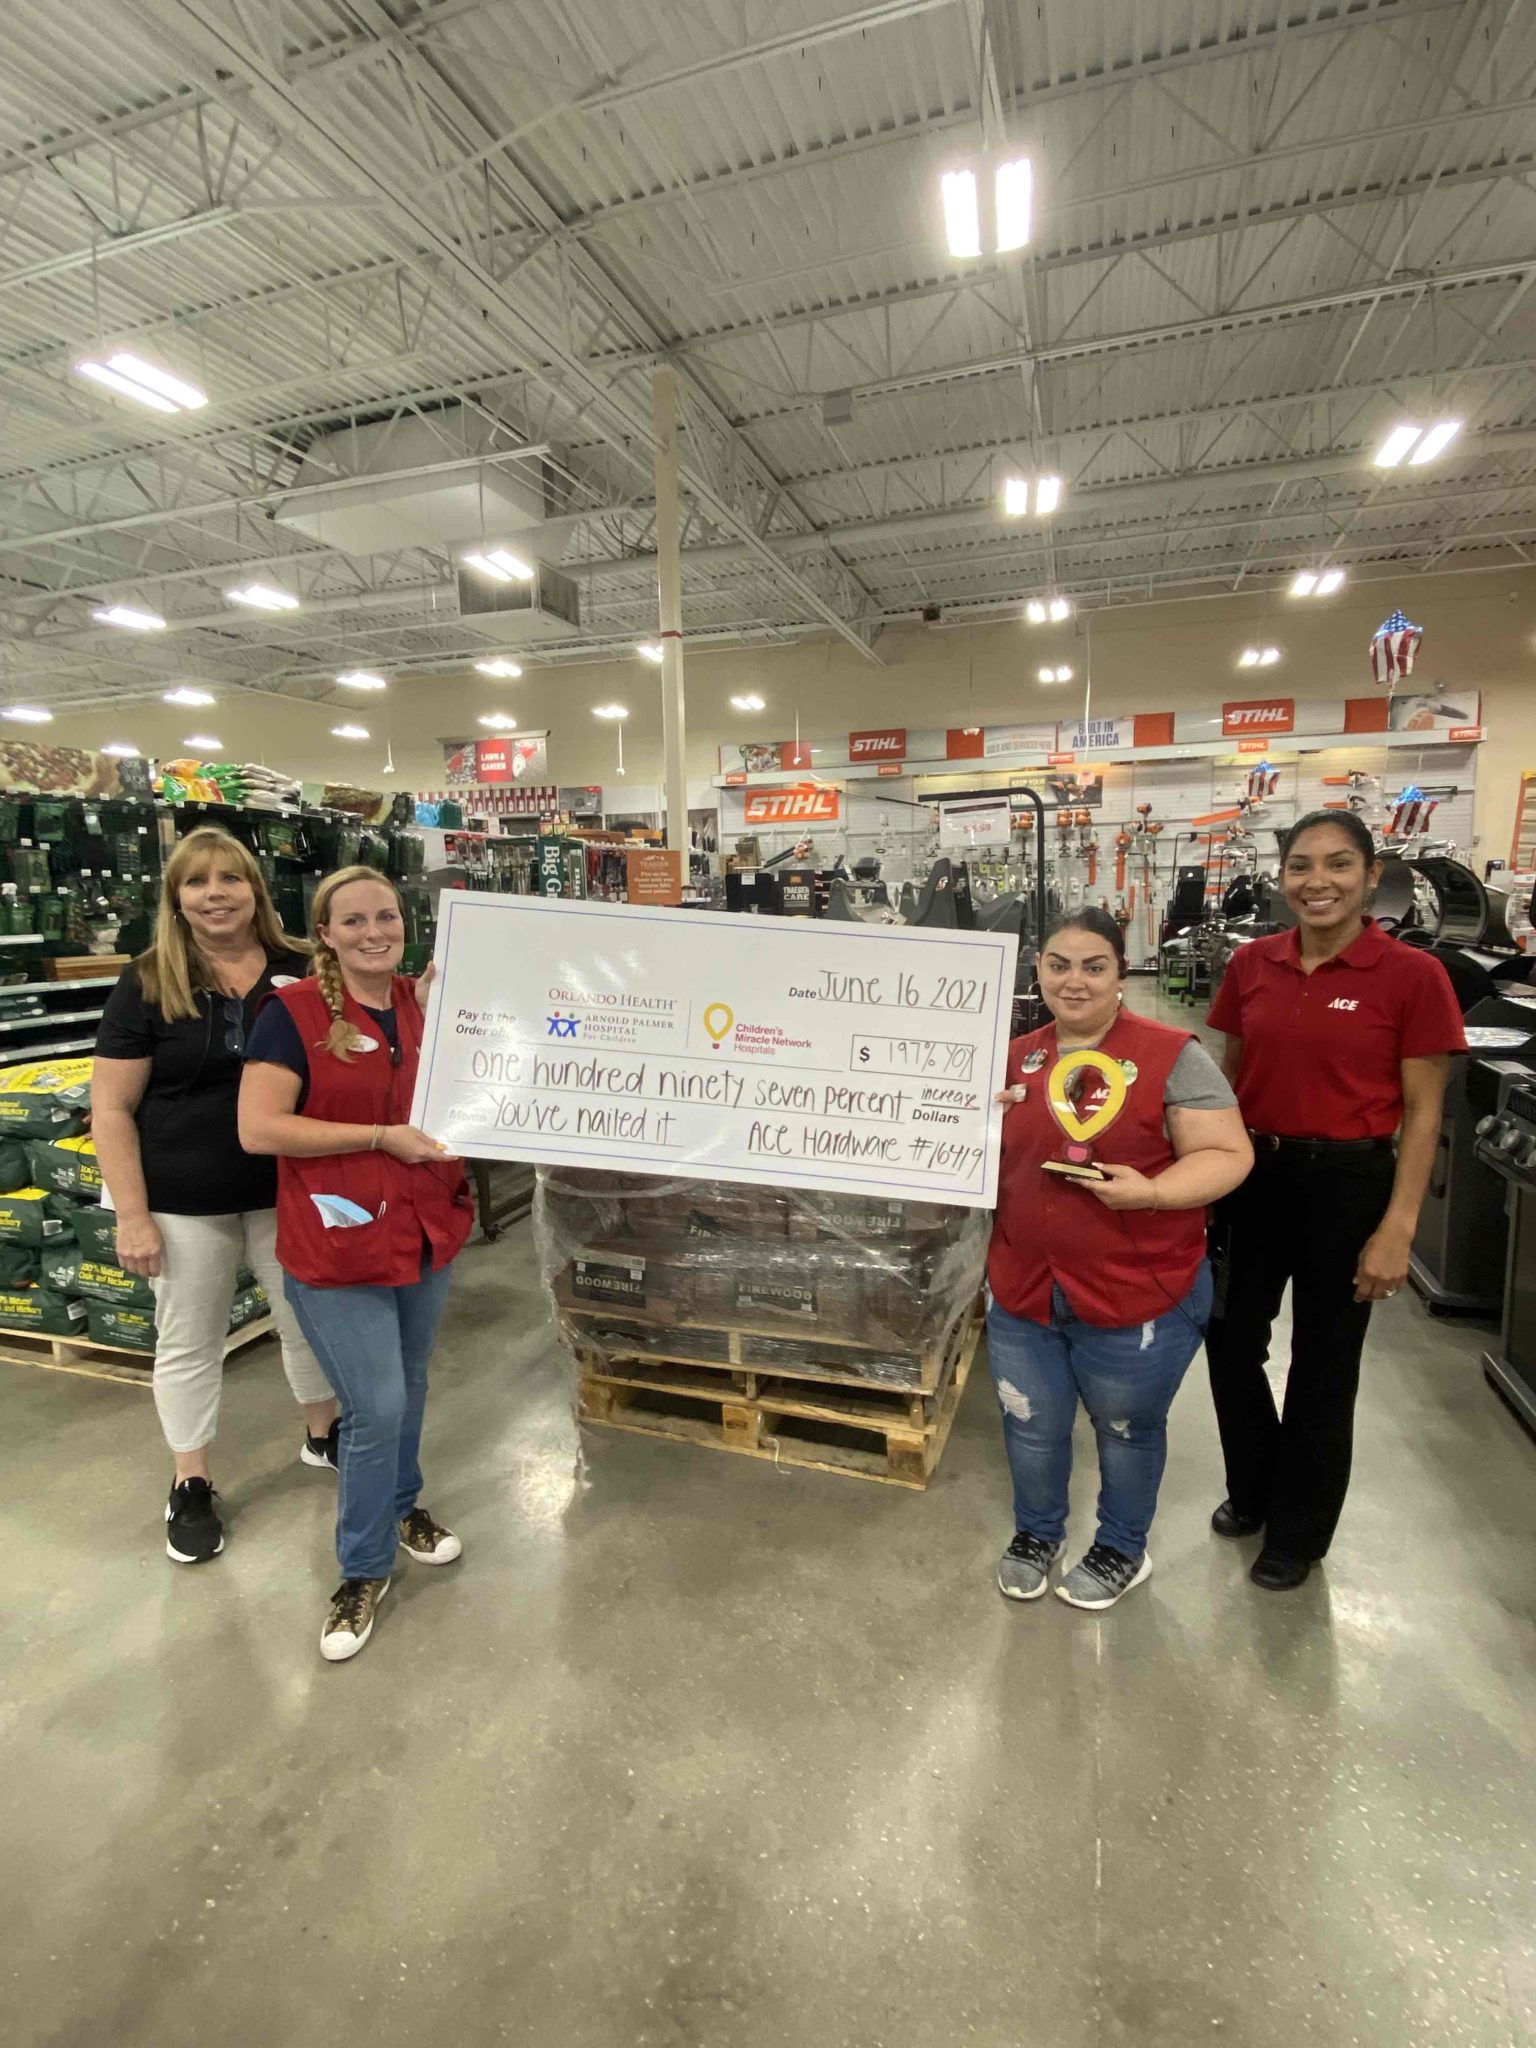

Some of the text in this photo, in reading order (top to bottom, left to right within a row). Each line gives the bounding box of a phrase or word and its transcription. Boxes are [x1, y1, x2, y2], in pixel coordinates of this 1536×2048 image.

[1227, 707, 1289, 725] STIHL
[1078, 720, 1114, 735] BILT IN
[1452, 729, 1481, 738] STIHL
[852, 737, 902, 752] STIHL
[1072, 733, 1120, 749] AMERICA
[1240, 742, 1267, 750] STIHL
[481, 752, 499, 762] LAWN
[481, 762, 507, 771] GARDEN
[879, 766, 900, 775] STIHL
[726, 775, 746, 783] STIHL
[746, 793, 833, 817] STIHL
[541, 846, 560, 876] Big
[548, 988, 617, 1005] ORLANDO
[788, 986, 817, 1000] Date
[818, 969, 883, 1004] June
[897, 972, 920, 1007] 16
[929, 976, 988, 1014] 2021
[1327, 997, 1359, 1011] ACE
[457, 1009, 516, 1023] Pay to the
[585, 1014, 675, 1030] ARNOLD PALMER
[456, 1024, 488, 1037] Order
[584, 1024, 638, 1036] HOSPITAL
[735, 1023, 784, 1037] Children's
[600, 1034, 637, 1044] Children
[734, 1033, 813, 1049] Miracle Network
[733, 1043, 776, 1056] Hospitals
[858, 1046, 871, 1063] $
[889, 1041, 936, 1072] 197%
[533, 1054, 646, 1095] hundred
[659, 1070, 744, 1108] ninety
[754, 1079, 815, 1112] seven
[823, 1085, 913, 1121] percent
[1090, 1088, 1111, 1099] AC
[912, 1108, 960, 1124] Dollars
[577, 1106, 648, 1141] nailed
[655, 1111, 677, 1144] it
[101, 1265, 125, 1279] Natural
[78, 1271, 94, 1281] Oak
[107, 1276, 136, 1289] Hickory
[576, 1275, 641, 1295] FIREWOOD
[738, 1283, 812, 1300] FIREWOOD
